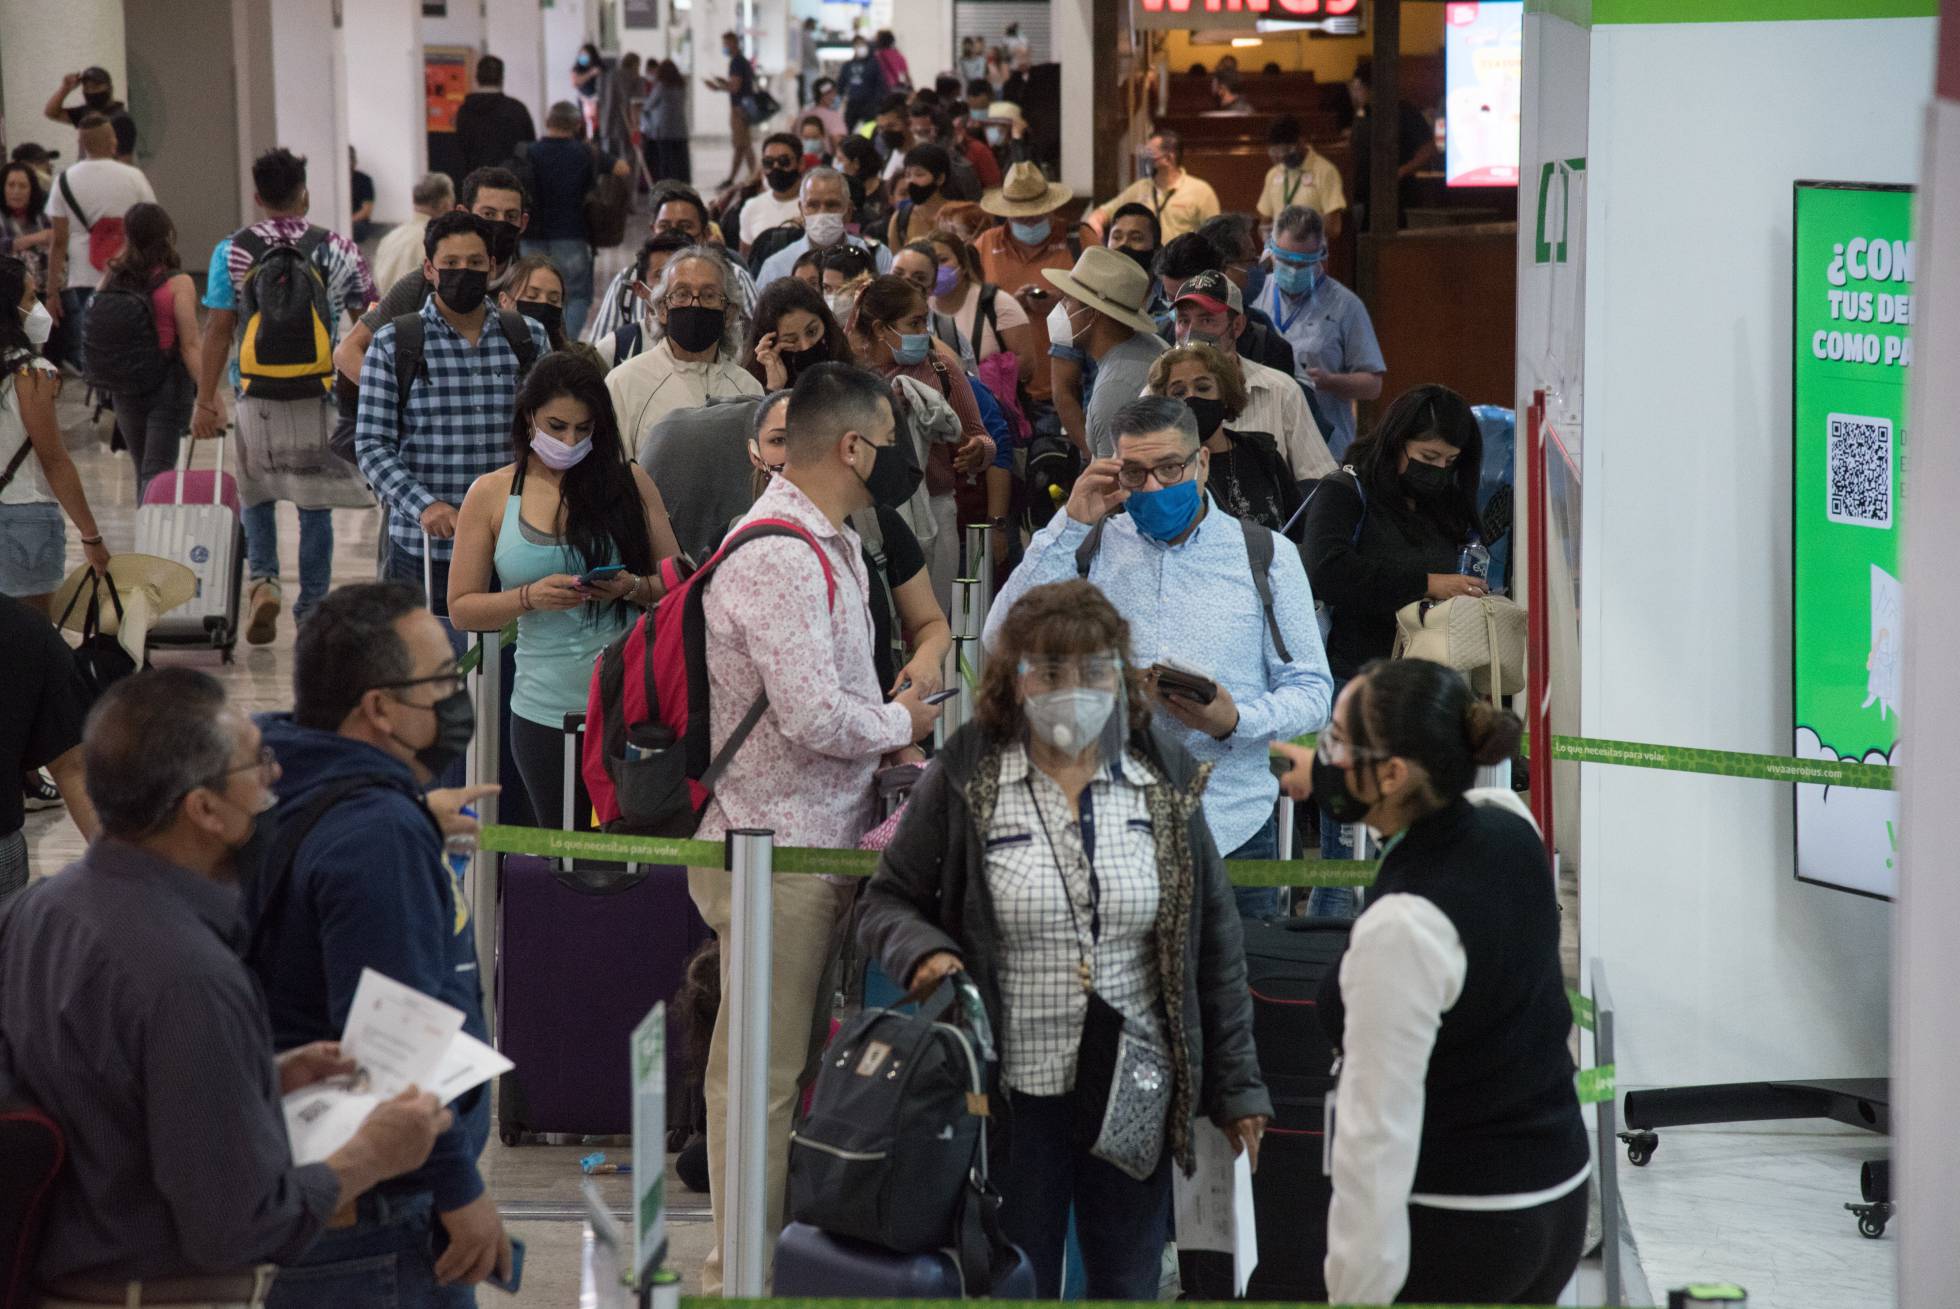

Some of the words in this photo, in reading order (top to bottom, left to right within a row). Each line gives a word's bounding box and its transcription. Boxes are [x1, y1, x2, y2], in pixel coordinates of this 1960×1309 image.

[1828, 289, 1873, 322] TUS
[1877, 292, 1915, 326] DE
[1812, 330, 1880, 364] COMO
[1555, 741, 1566, 752] Lo
[1567, 745, 1583, 755] que
[1584, 746, 1622, 758] necesitas
[1623, 750, 1643, 761] para
[1766, 764, 1842, 779] vivaaerobus.com
[550, 837, 562, 848] Lo
[563, 840, 581, 851] que
[583, 842, 628, 854] necesitas
[630, 845, 652, 856] para
